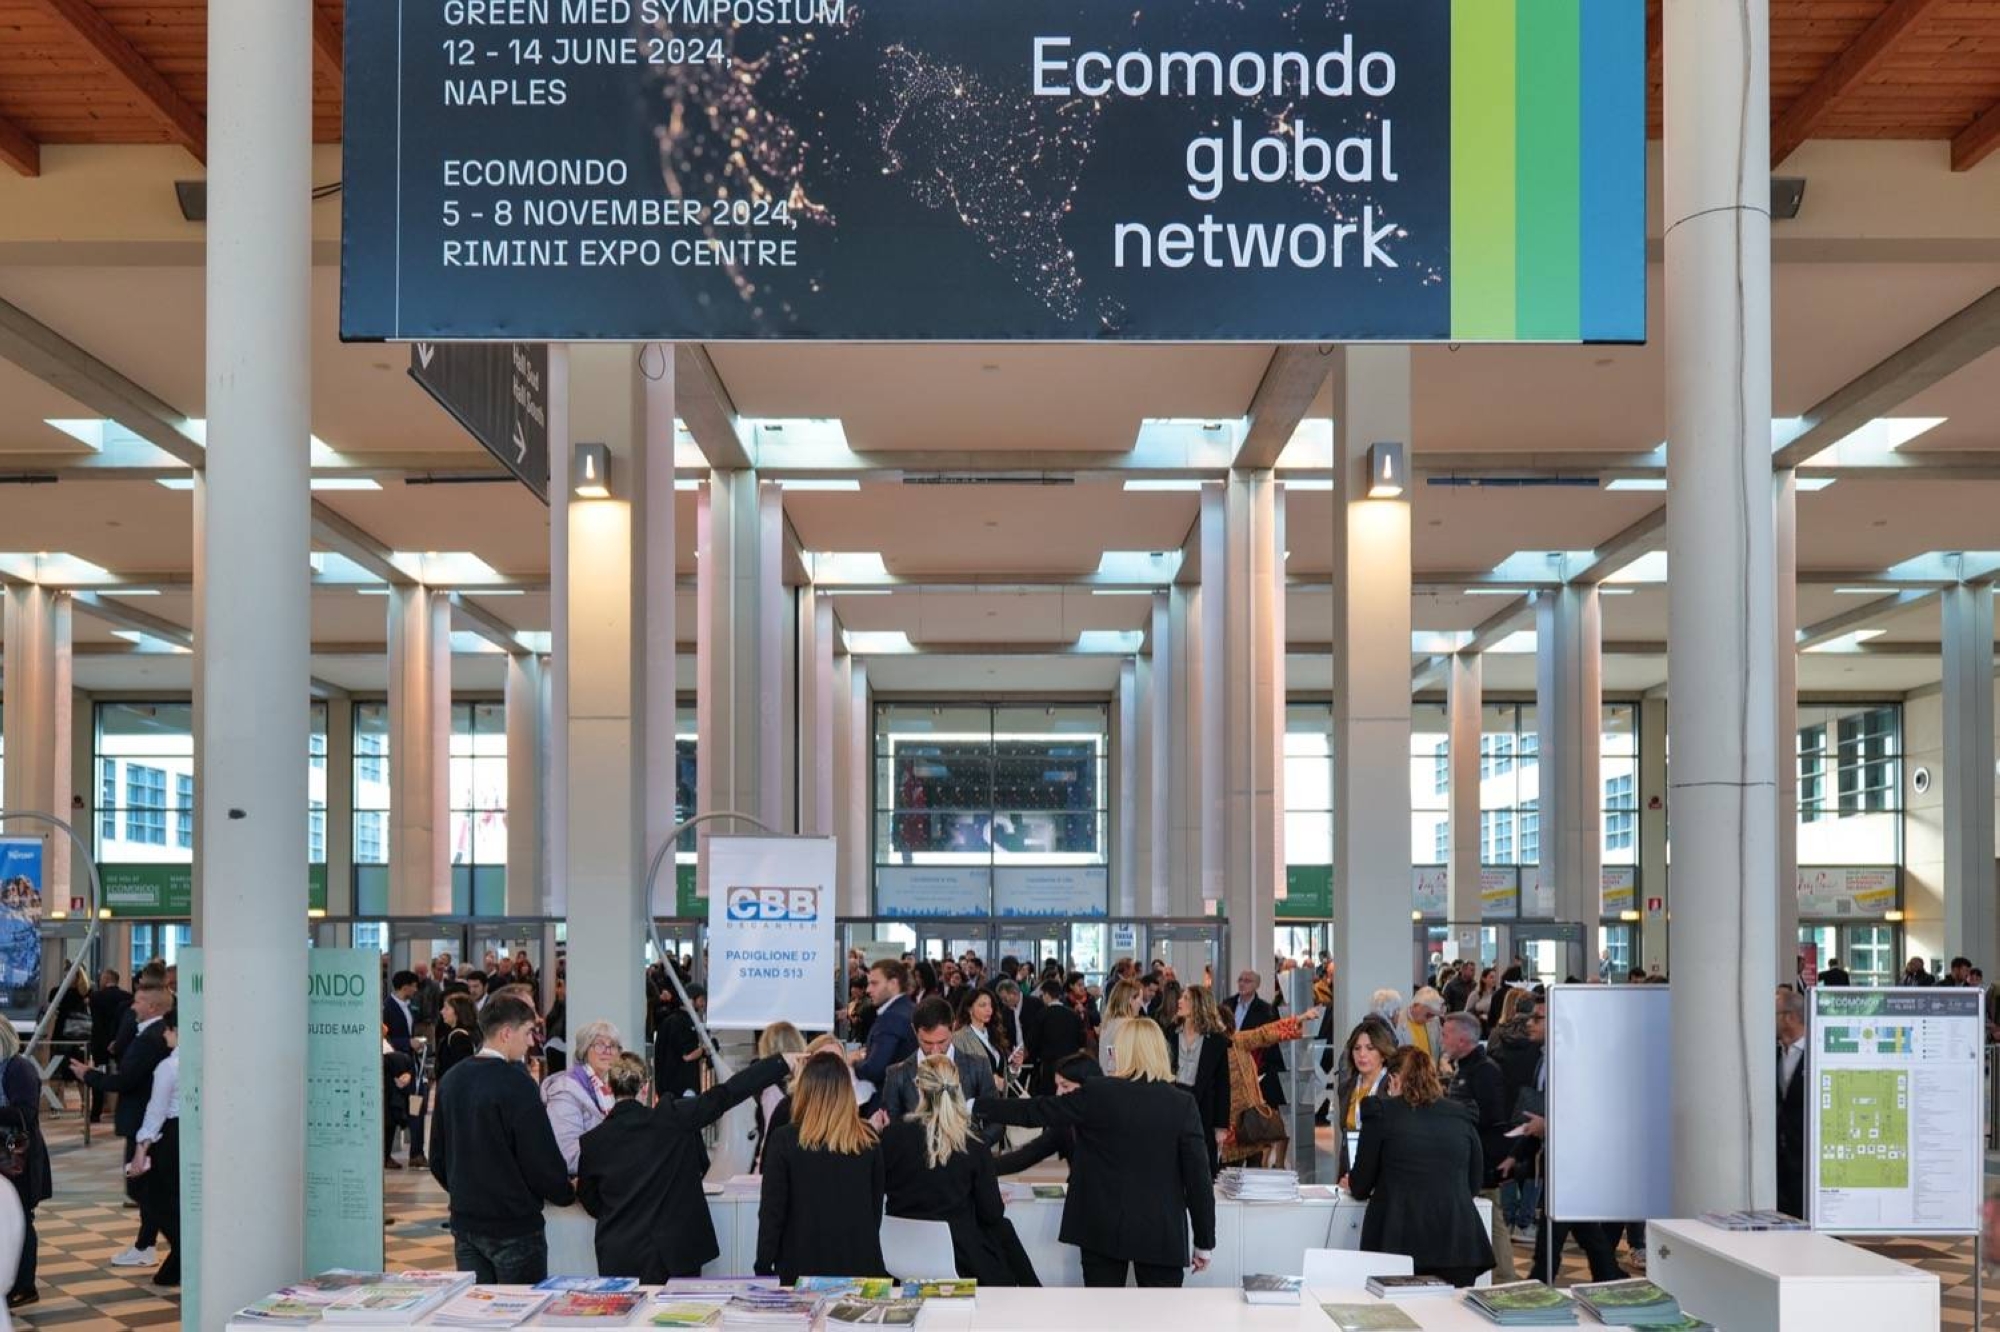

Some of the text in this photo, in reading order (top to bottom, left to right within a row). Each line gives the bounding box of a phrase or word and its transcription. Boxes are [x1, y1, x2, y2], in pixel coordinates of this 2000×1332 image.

[444, 0, 846, 25] GREEN MED SYMPOSIUM
[443, 39, 475, 65] 12
[508, 39, 543, 65] 14
[551, 39, 637, 65] JUNE
[647, 38, 733, 69] 2024,
[1033, 34, 1397, 96] Ecomondo
[444, 78, 567, 105] NAPLES
[443, 159, 628, 186] ECOMONDO
[1186, 119, 1398, 201] global
[442, 200, 460, 227] 5
[494, 200, 513, 226] 8
[524, 200, 703, 226] NOVEMBER
[713, 199, 798, 230] 2024,
[1115, 205, 1399, 268] network
[443, 239, 798, 267] RIMINI EXPO CENTRE
[728, 887, 816, 919] CBB
[726, 950, 817, 961] PADIGLIONE D7
[738, 967, 803, 980] STAND 513
[341, 1023, 365, 1035] MAP
